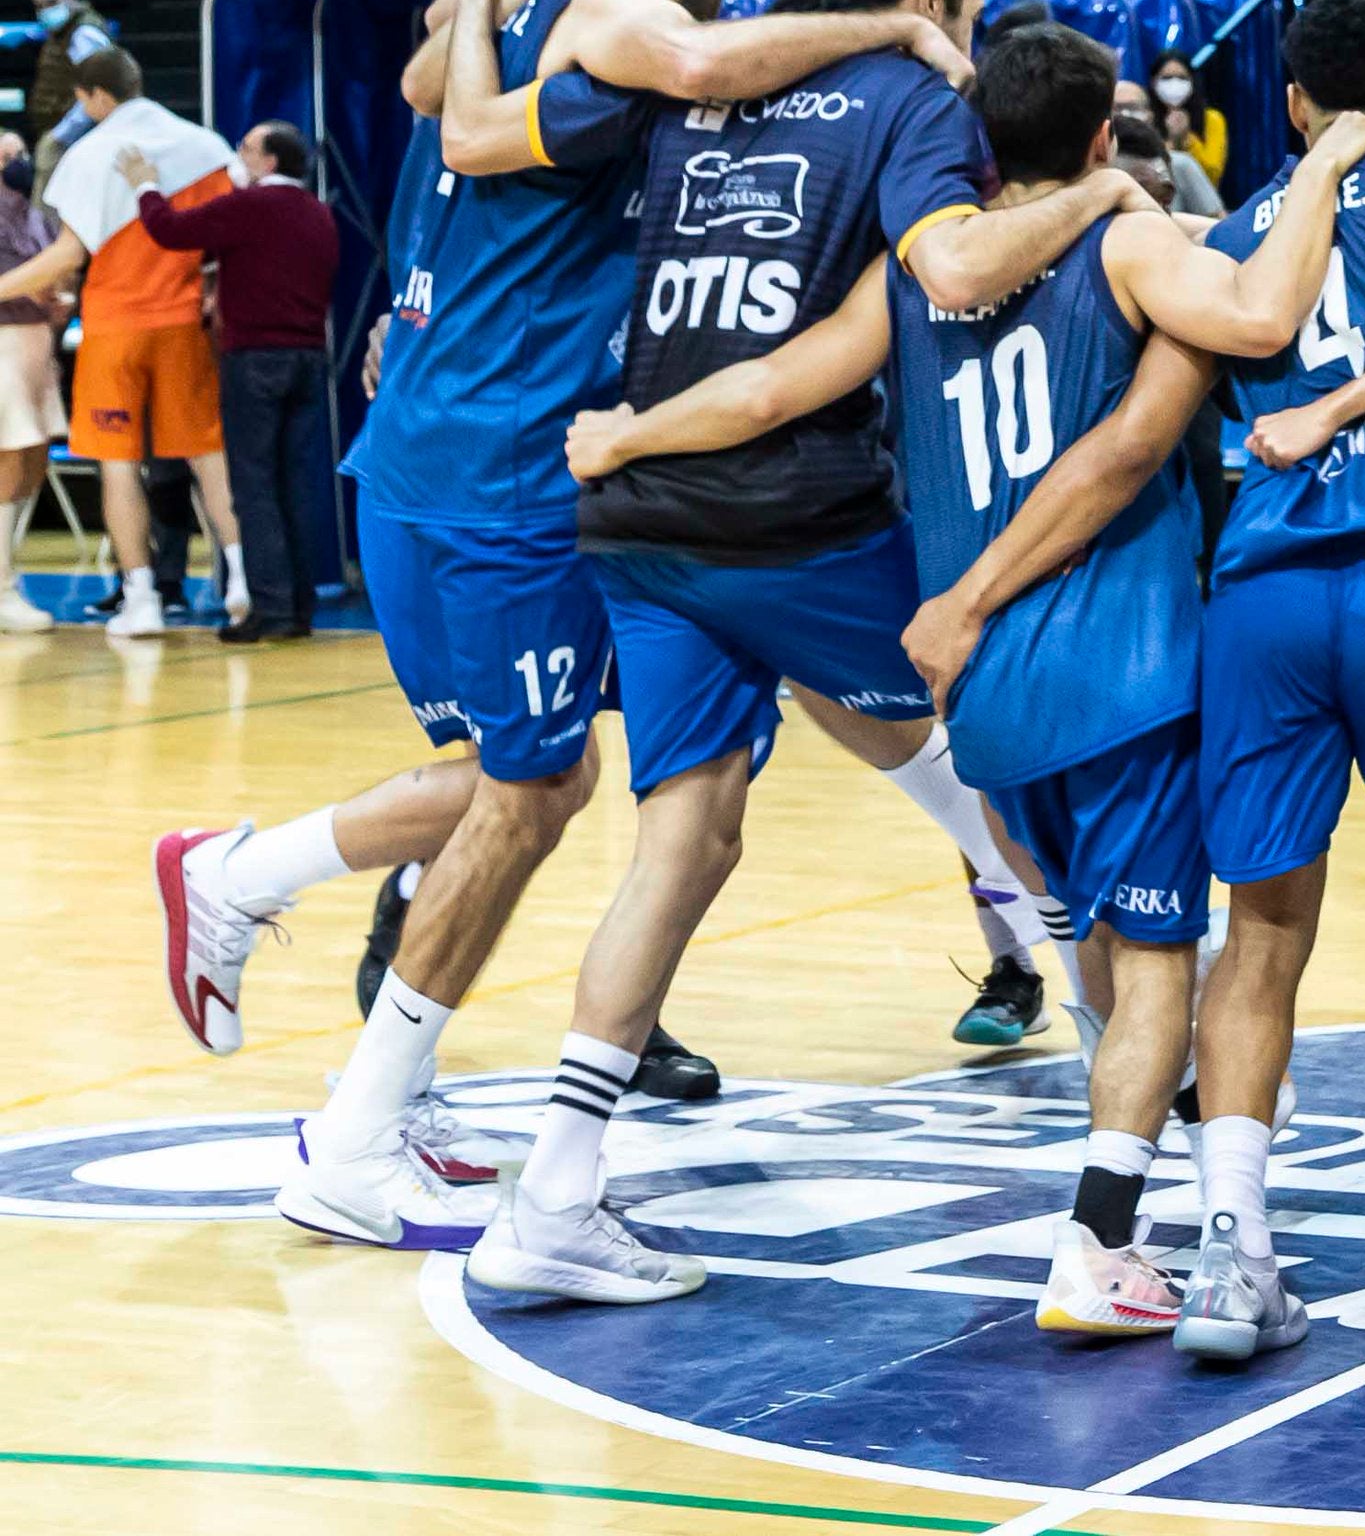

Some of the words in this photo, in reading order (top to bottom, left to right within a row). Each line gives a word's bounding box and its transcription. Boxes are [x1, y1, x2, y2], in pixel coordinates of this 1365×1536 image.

[646, 256, 802, 337] OTIS
[943, 324, 1055, 511] 10
[514, 645, 576, 716] 12
